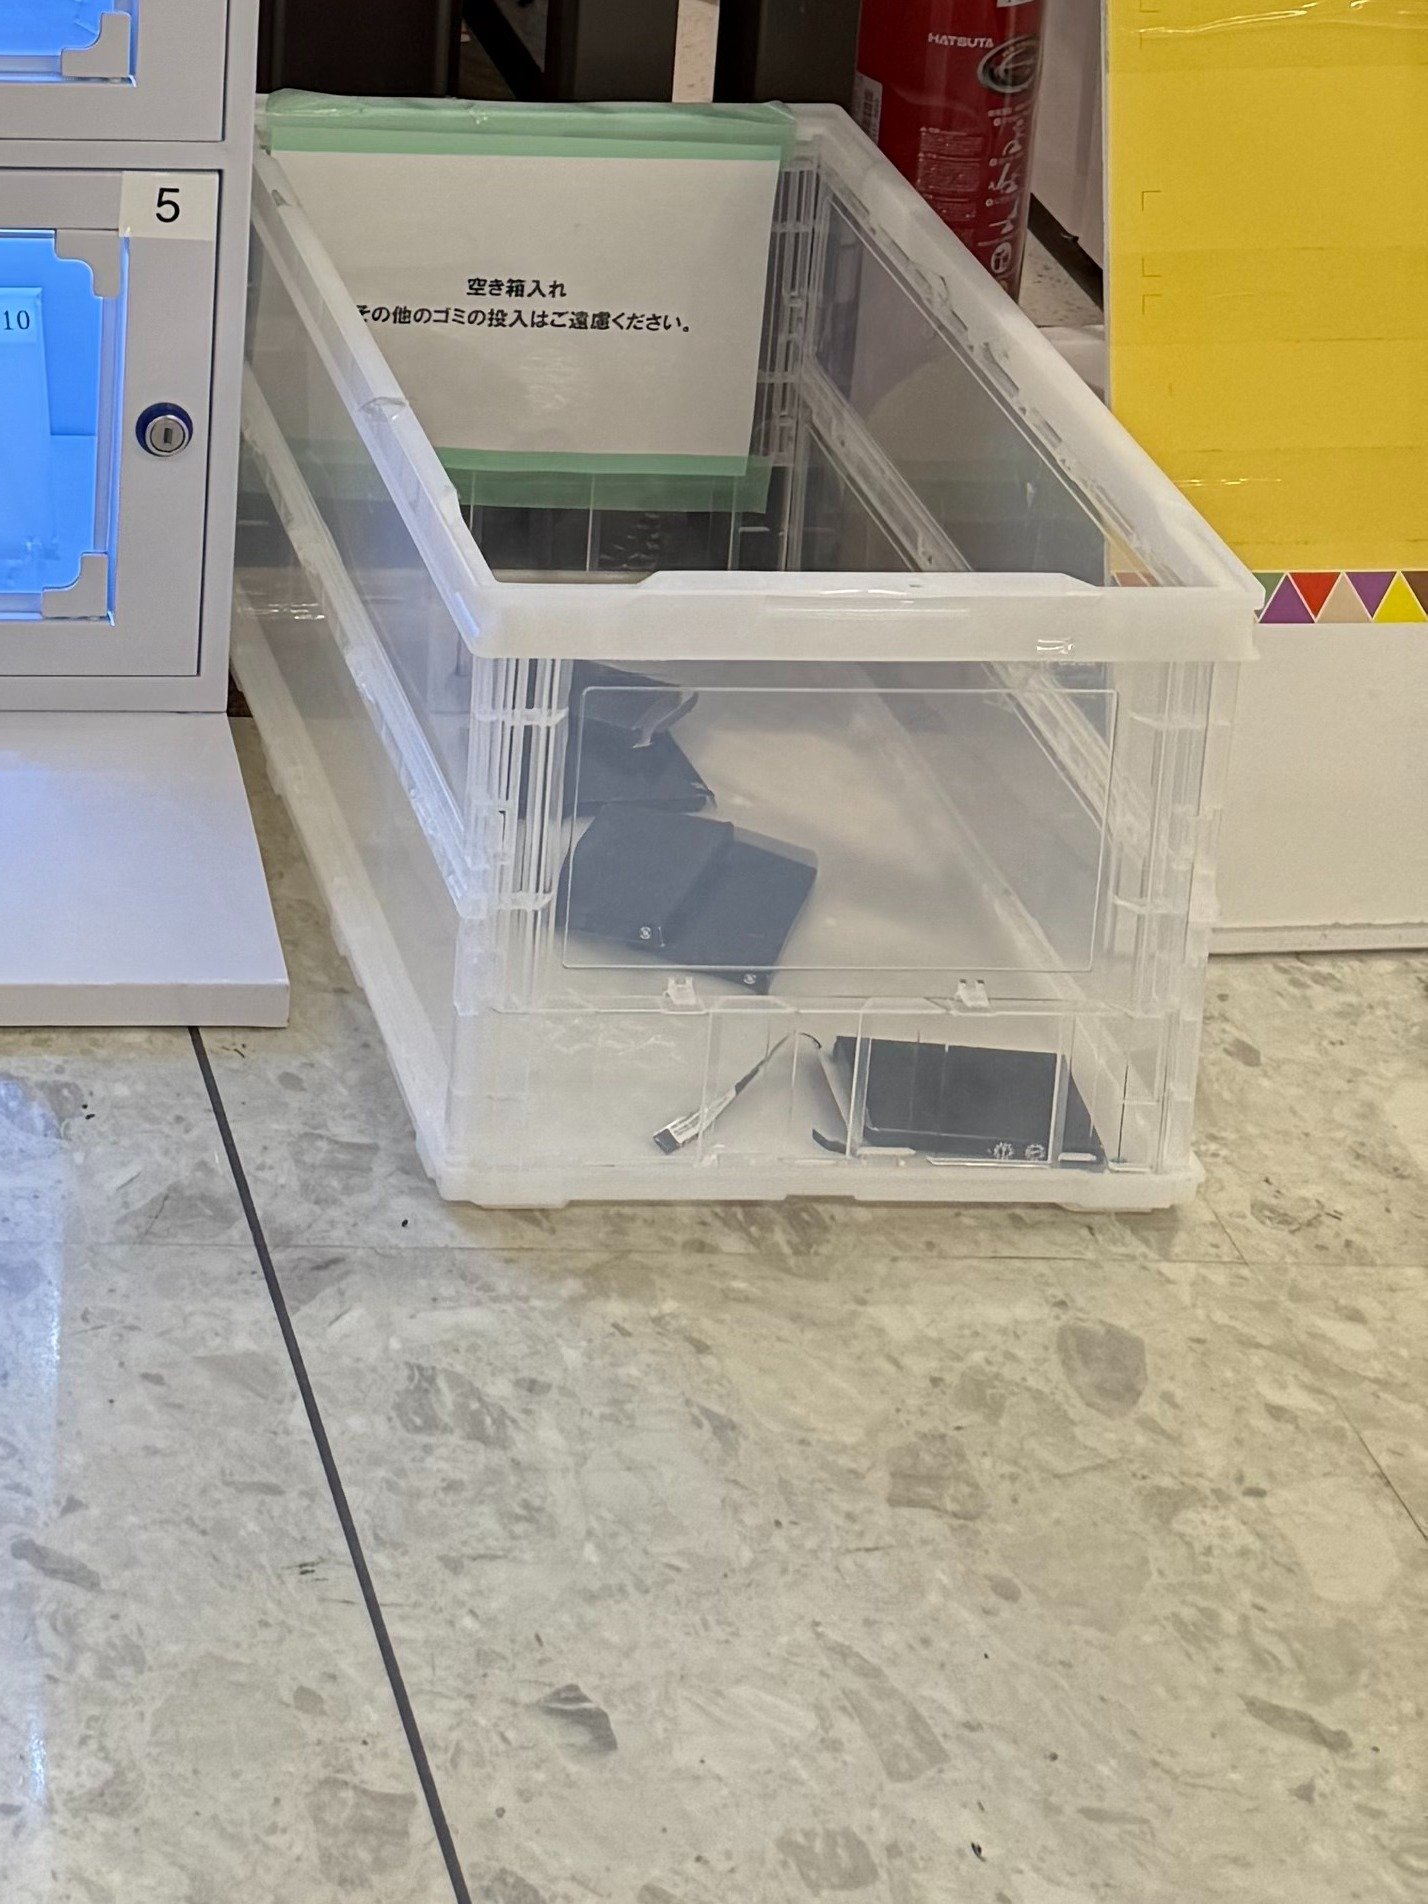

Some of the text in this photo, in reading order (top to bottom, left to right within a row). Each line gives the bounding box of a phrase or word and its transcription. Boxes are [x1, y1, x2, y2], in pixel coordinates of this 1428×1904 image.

[927, 31, 994, 49] HATSUTA
[155, 187, 181, 224] 5
[466, 276, 568, 300] 空き箱入れ
